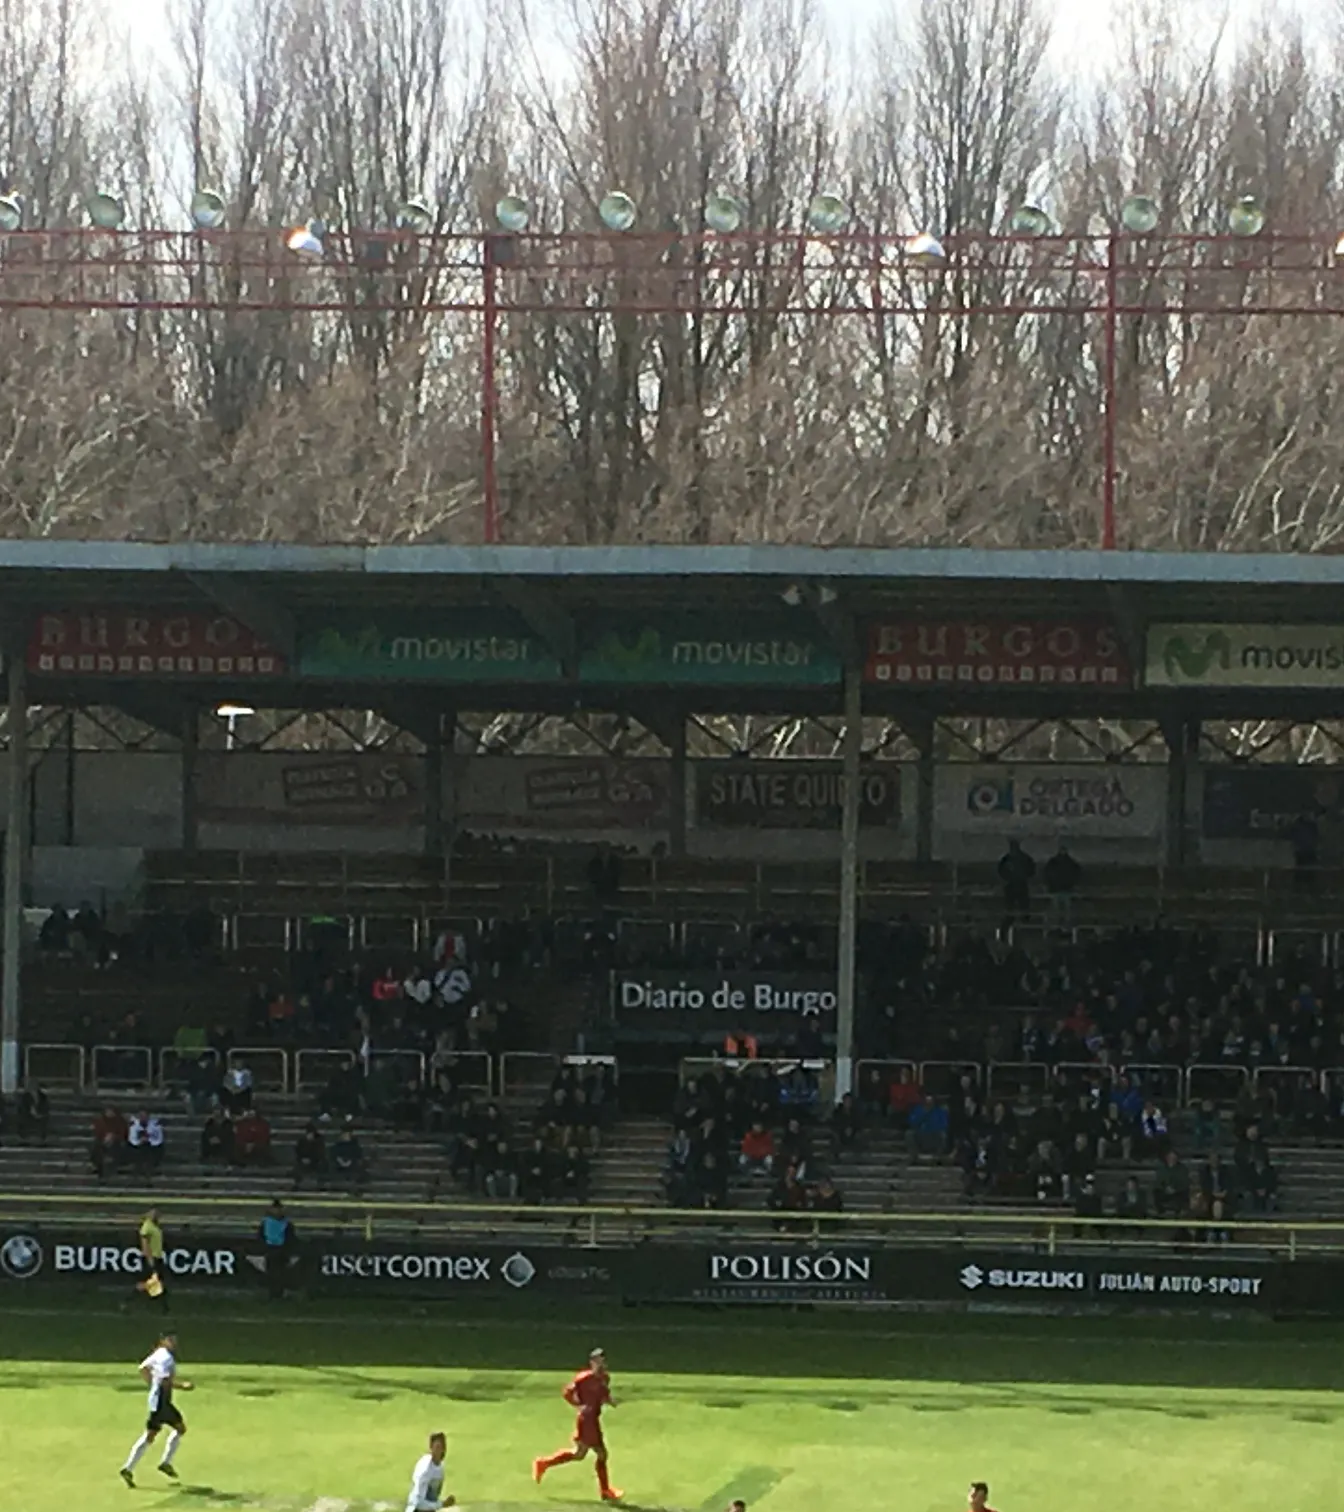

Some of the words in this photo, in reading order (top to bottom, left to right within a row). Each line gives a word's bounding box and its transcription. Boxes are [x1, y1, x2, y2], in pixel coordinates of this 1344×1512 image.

[389, 634, 531, 662] movistar
[671, 637, 816, 667] movistar
[875, 624, 1117, 658] BURGOS
[710, 774, 786, 806] STATE
[1020, 798, 1134, 817] DELGADO
[620, 980, 705, 1010] Diario
[711, 981, 746, 1011] de
[753, 983, 837, 1018] Burgo
[54, 1244, 237, 1276] BURGCAR
[320, 1251, 491, 1281] asercomex
[709, 1249, 872, 1281] POLISÓN
[987, 1270, 1085, 1290] SUZUKI
[1097, 1269, 1156, 1293] JULIÁN
[1159, 1273, 1263, 1297] AUTO-SPORT
